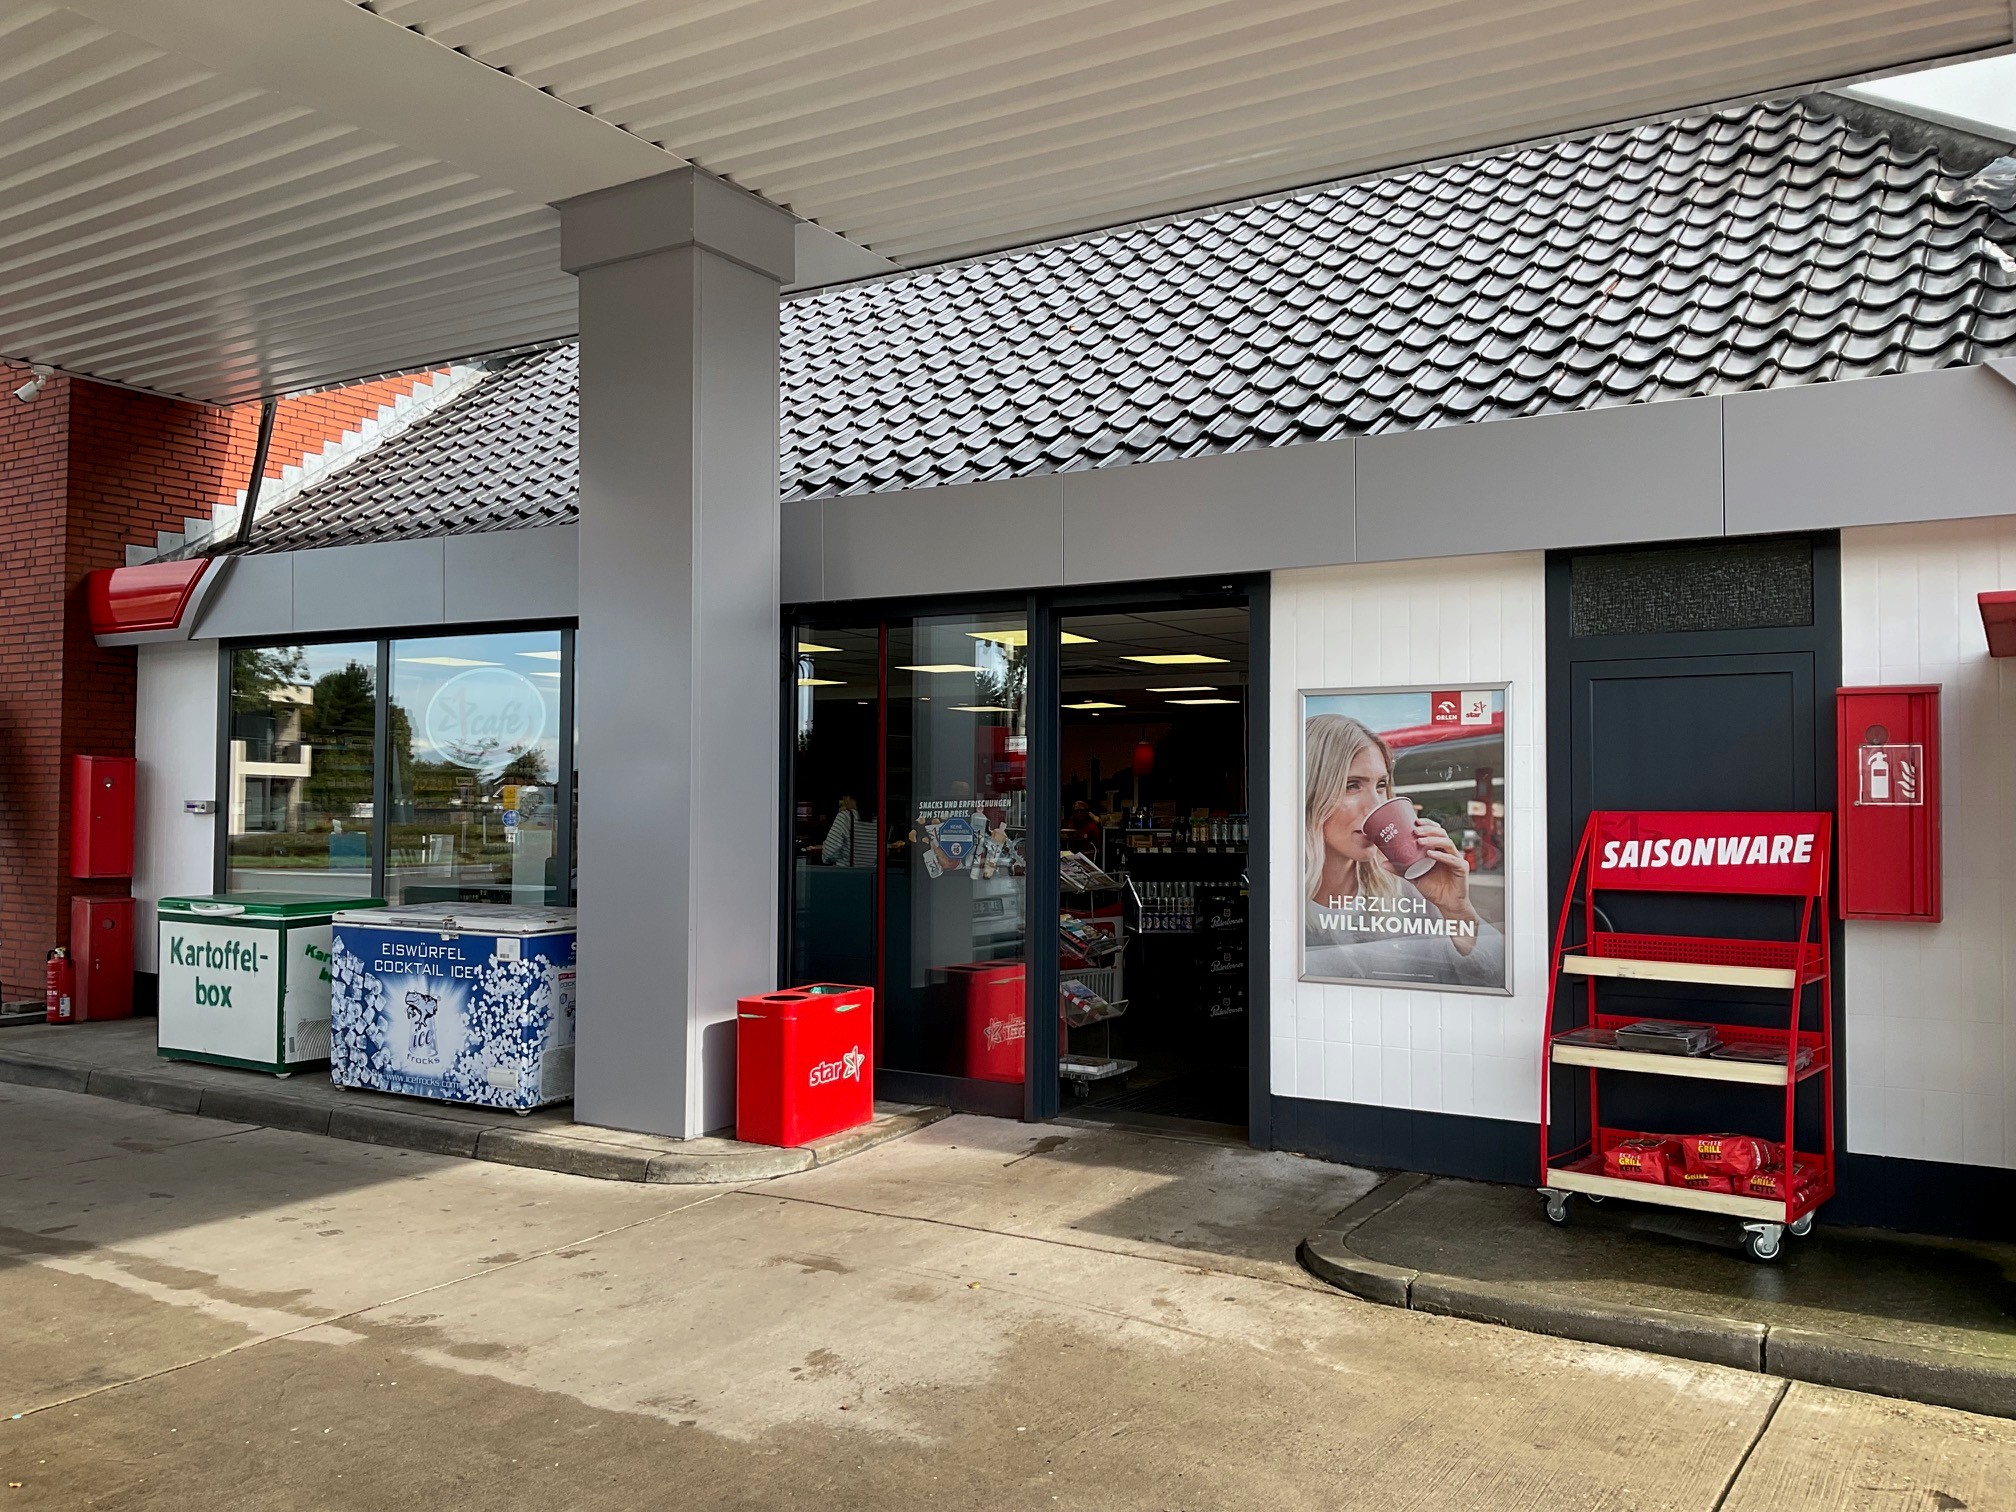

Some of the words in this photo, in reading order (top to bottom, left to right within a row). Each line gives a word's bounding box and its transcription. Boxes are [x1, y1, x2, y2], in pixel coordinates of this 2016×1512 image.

[919, 801, 943, 809] SNACKS
[944, 801, 958, 809] UND
[959, 799, 1012, 808] ERFRISCHUNGEN
[919, 810, 932, 818] ZUM
[949, 809, 971, 818] PREIS.
[1380, 823, 1394, 838] stop
[1601, 834, 1815, 869] SAISONWARE
[1329, 895, 1427, 914] HERZLICH
[1319, 914, 1475, 937] WILLKOMMEN
[170, 936, 269, 973] Kartoffel-
[382, 942, 466, 960] EISWÜRFEL
[374, 960, 444, 977] COCKTAIL
[450, 965, 474, 979] ICE
[195, 976, 233, 1008] box
[406, 1053, 441, 1065] frocks
[385, 1073, 460, 1089] www.icefrocks.com
[810, 1061, 843, 1087] star
[1698, 1145, 1722, 1153] GRILL
[1619, 1157, 1642, 1166] GRILL
[1750, 1178, 1776, 1187] GRILL
